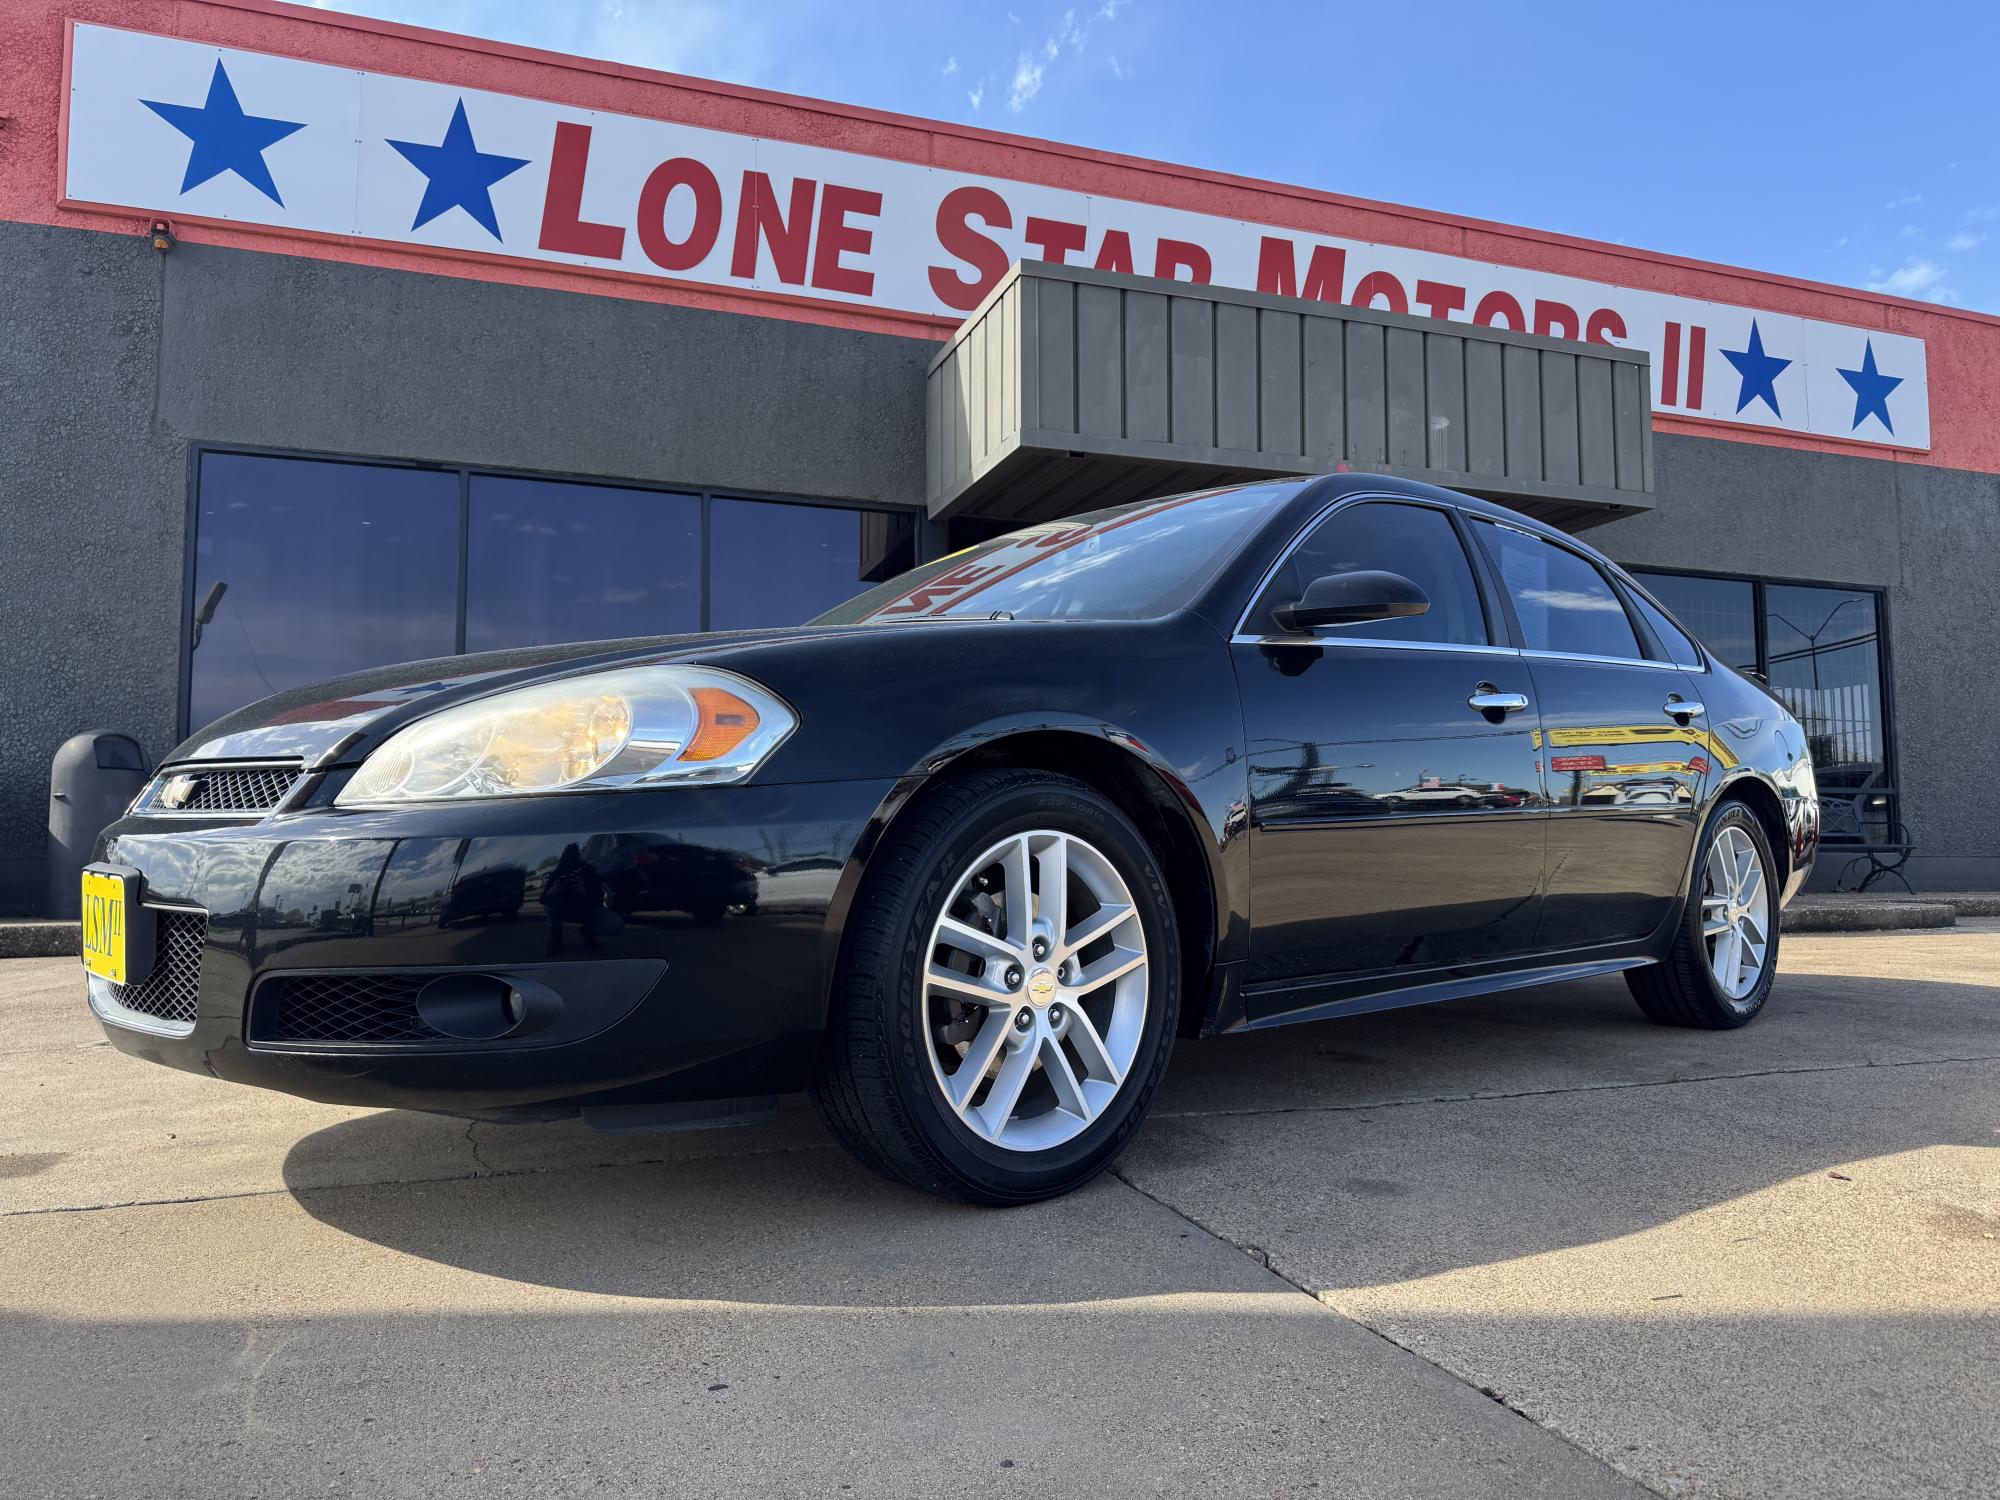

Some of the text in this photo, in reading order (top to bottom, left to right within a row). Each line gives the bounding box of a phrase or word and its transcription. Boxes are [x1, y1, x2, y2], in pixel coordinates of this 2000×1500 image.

[537, 121, 883, 297] LONE
[1661, 321, 1706, 410] II
[901, 851, 956, 1096] GOODYEAR
